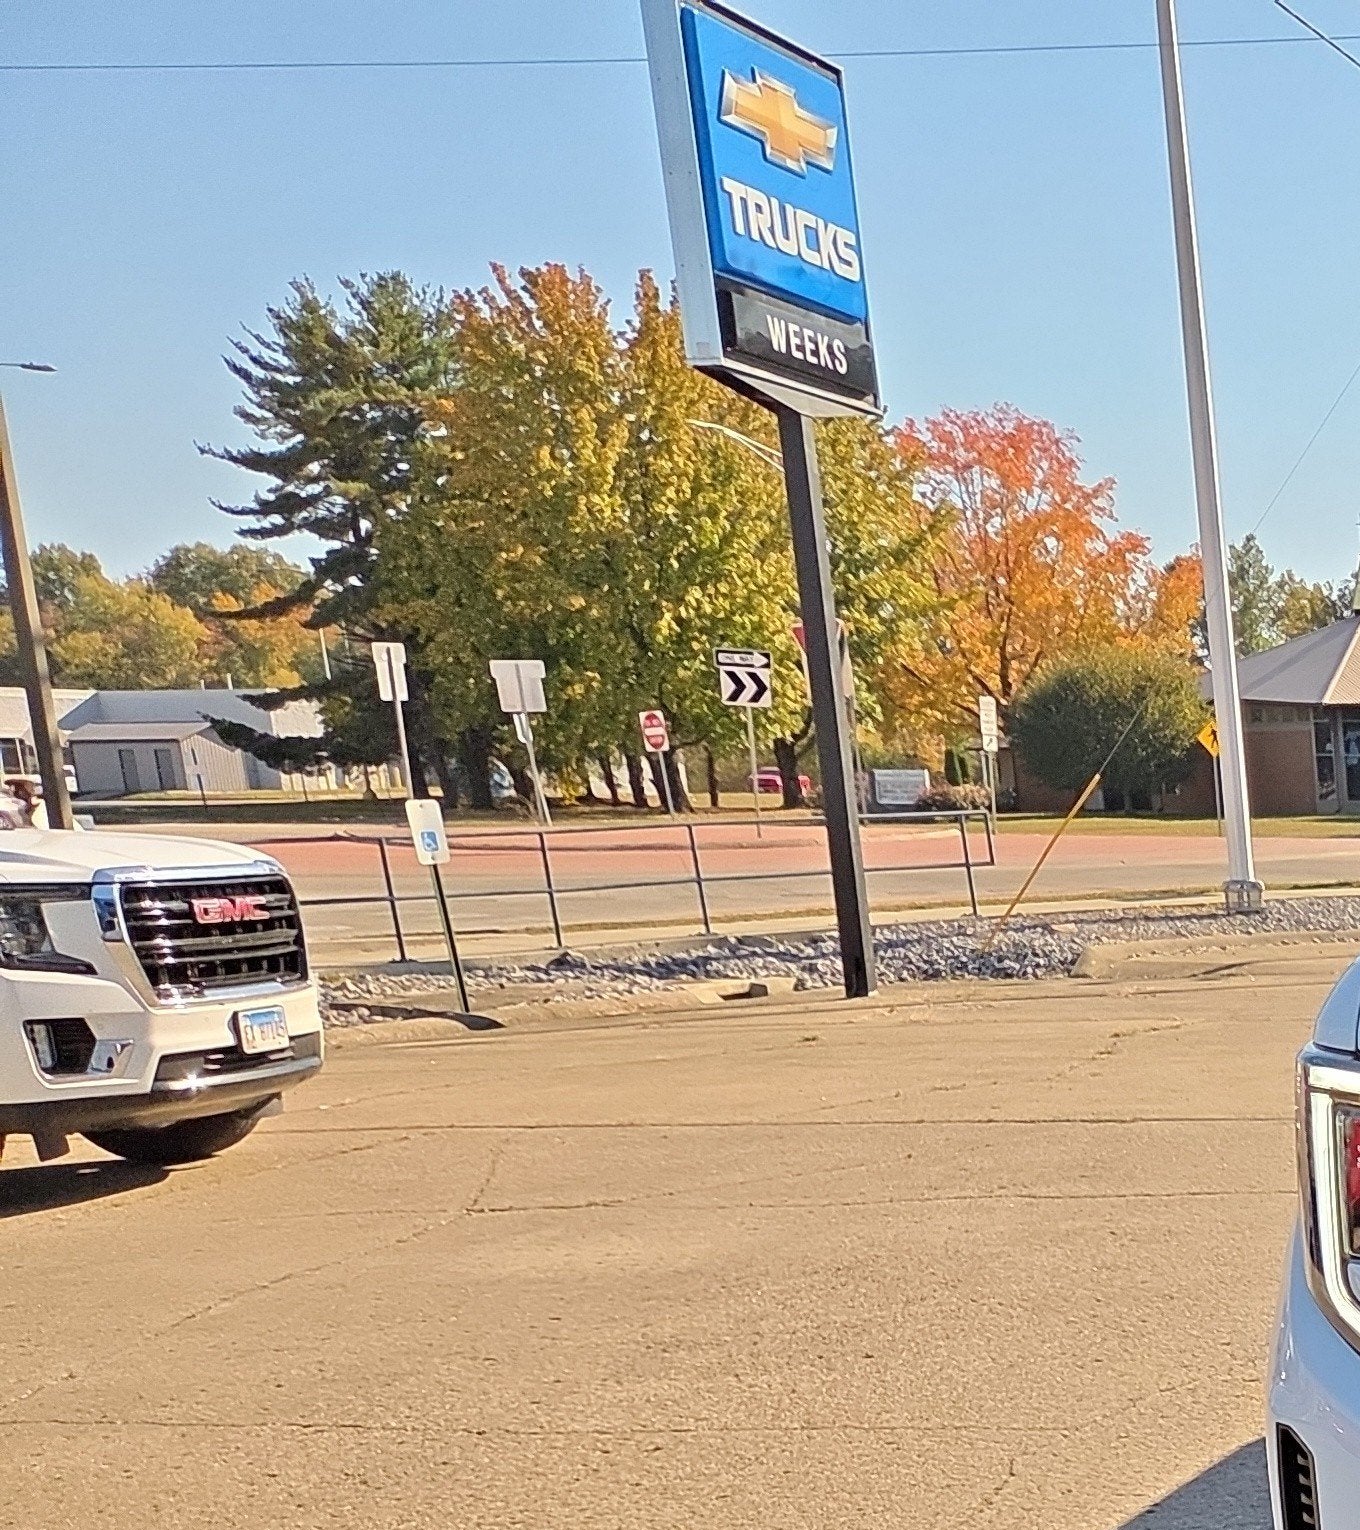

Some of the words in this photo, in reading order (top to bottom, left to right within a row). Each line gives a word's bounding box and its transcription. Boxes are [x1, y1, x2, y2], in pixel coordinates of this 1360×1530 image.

[721, 177, 861, 282] TRUCKS
[766, 314, 848, 375] WEEKS
[191, 895, 271, 924] GMC
